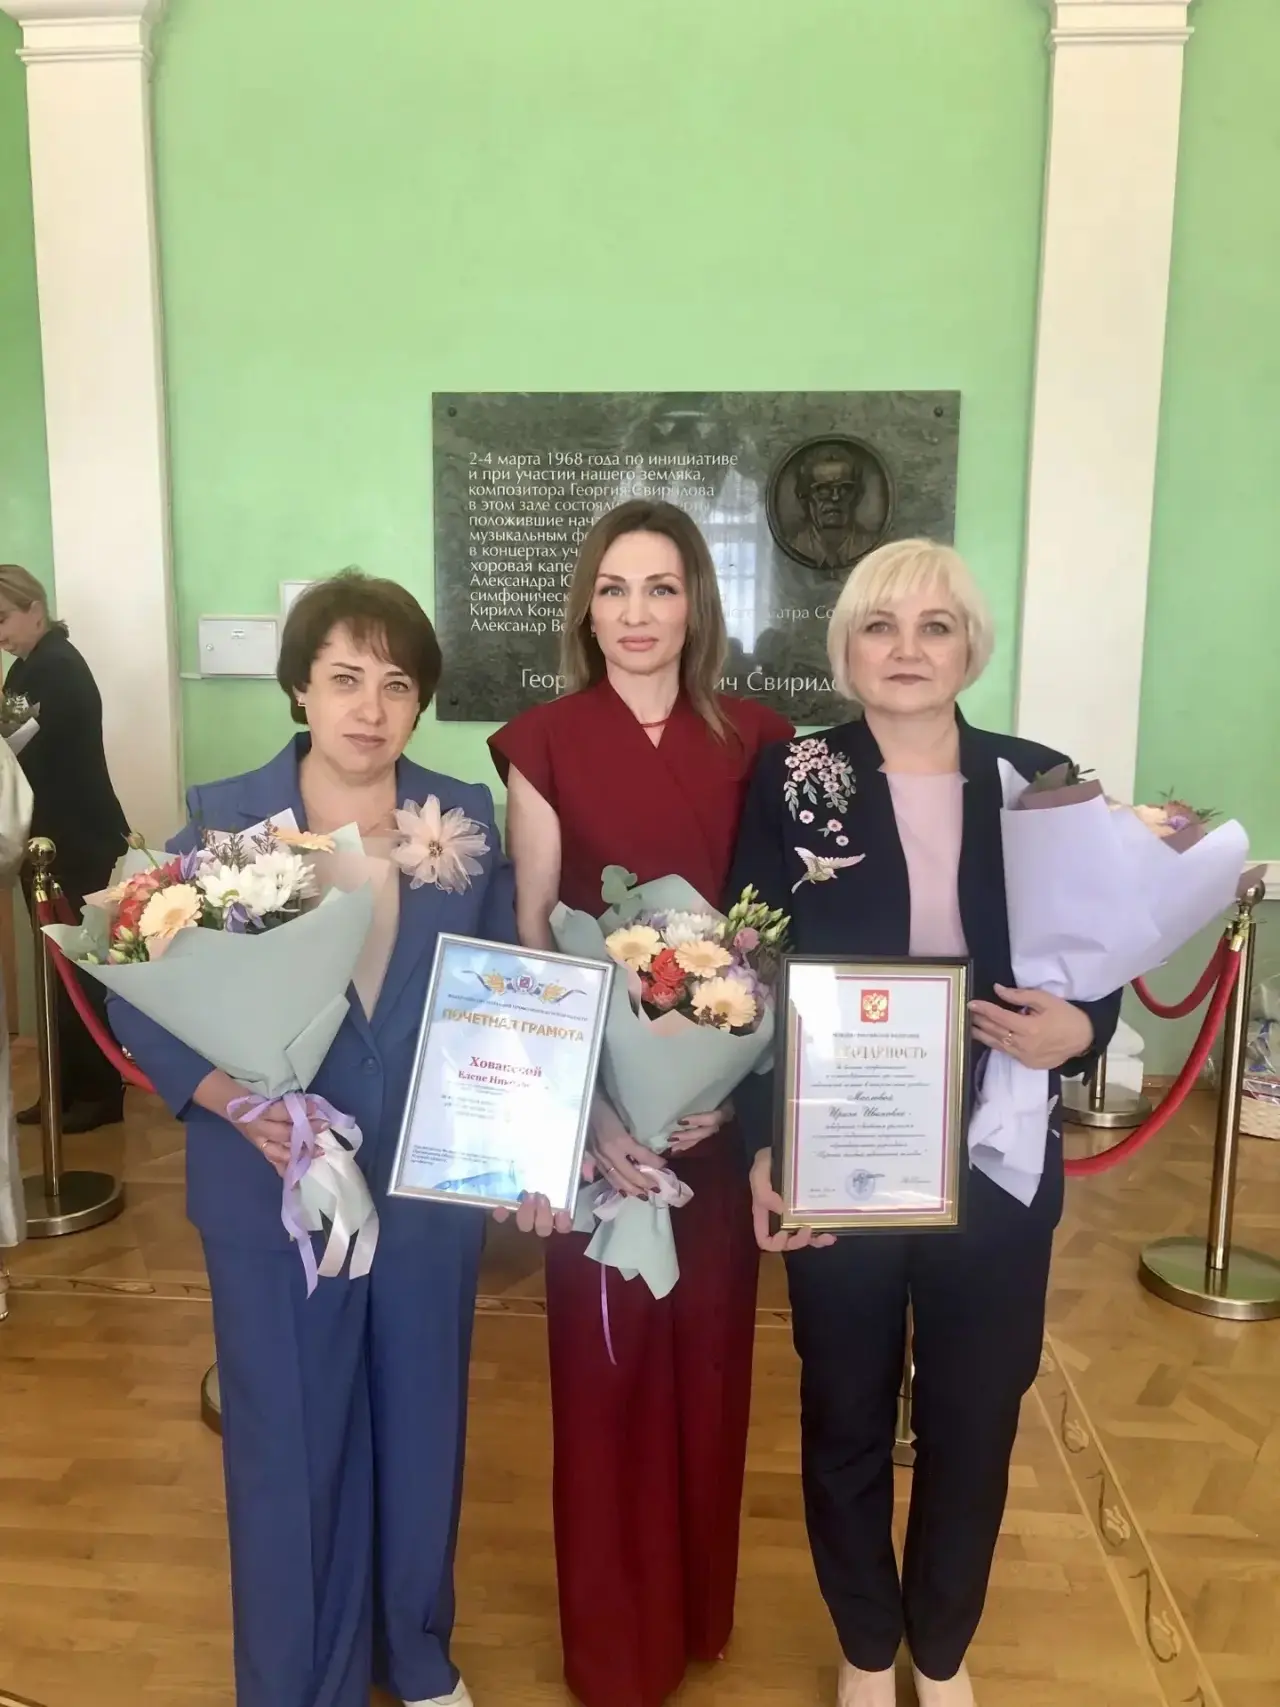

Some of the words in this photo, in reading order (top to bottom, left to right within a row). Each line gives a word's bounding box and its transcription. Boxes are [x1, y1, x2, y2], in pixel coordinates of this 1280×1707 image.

[469, 452, 492, 465] 2-4
[498, 455, 541, 469] марта
[547, 452, 583, 466] 1968
[588, 455, 620, 466] года
[625, 455, 644, 466] по
[648, 455, 739, 466] инициативе
[468, 470, 478, 480] и
[483, 470, 511, 484] при
[516, 470, 576, 484] участии
[581, 470, 635, 481] нашего
[641, 470, 705, 482] земляка,
[469, 485, 565, 500] композитора
[570, 483, 627, 500] Георгия
[469, 501, 477, 511] в
[481, 501, 515, 511] этом
[519, 501, 551, 511] зале
[469, 516, 564, 527] положившие
[568, 516, 599, 527] нач
[470, 530, 567, 545] музыкальным
[469, 546, 477, 556] в
[482, 546, 557, 561] концертах
[562, 546, 579, 561] уч
[470, 561, 533, 575] хоровая
[538, 562, 574, 573] капе
[469, 573, 555, 590] Александра
[560, 574, 574, 587] Ю
[470, 588, 570, 606] симфоническ
[470, 603, 523, 620] Кирилл
[814, 605, 835, 619] Со
[470, 618, 547, 635] Александр
[522, 668, 567, 694] Геор
[713, 676, 738, 691] ич
[520, 1022, 585, 1042] ГРАМОТА
[846, 1045, 928, 1060] ОДАРНОСТЬ
